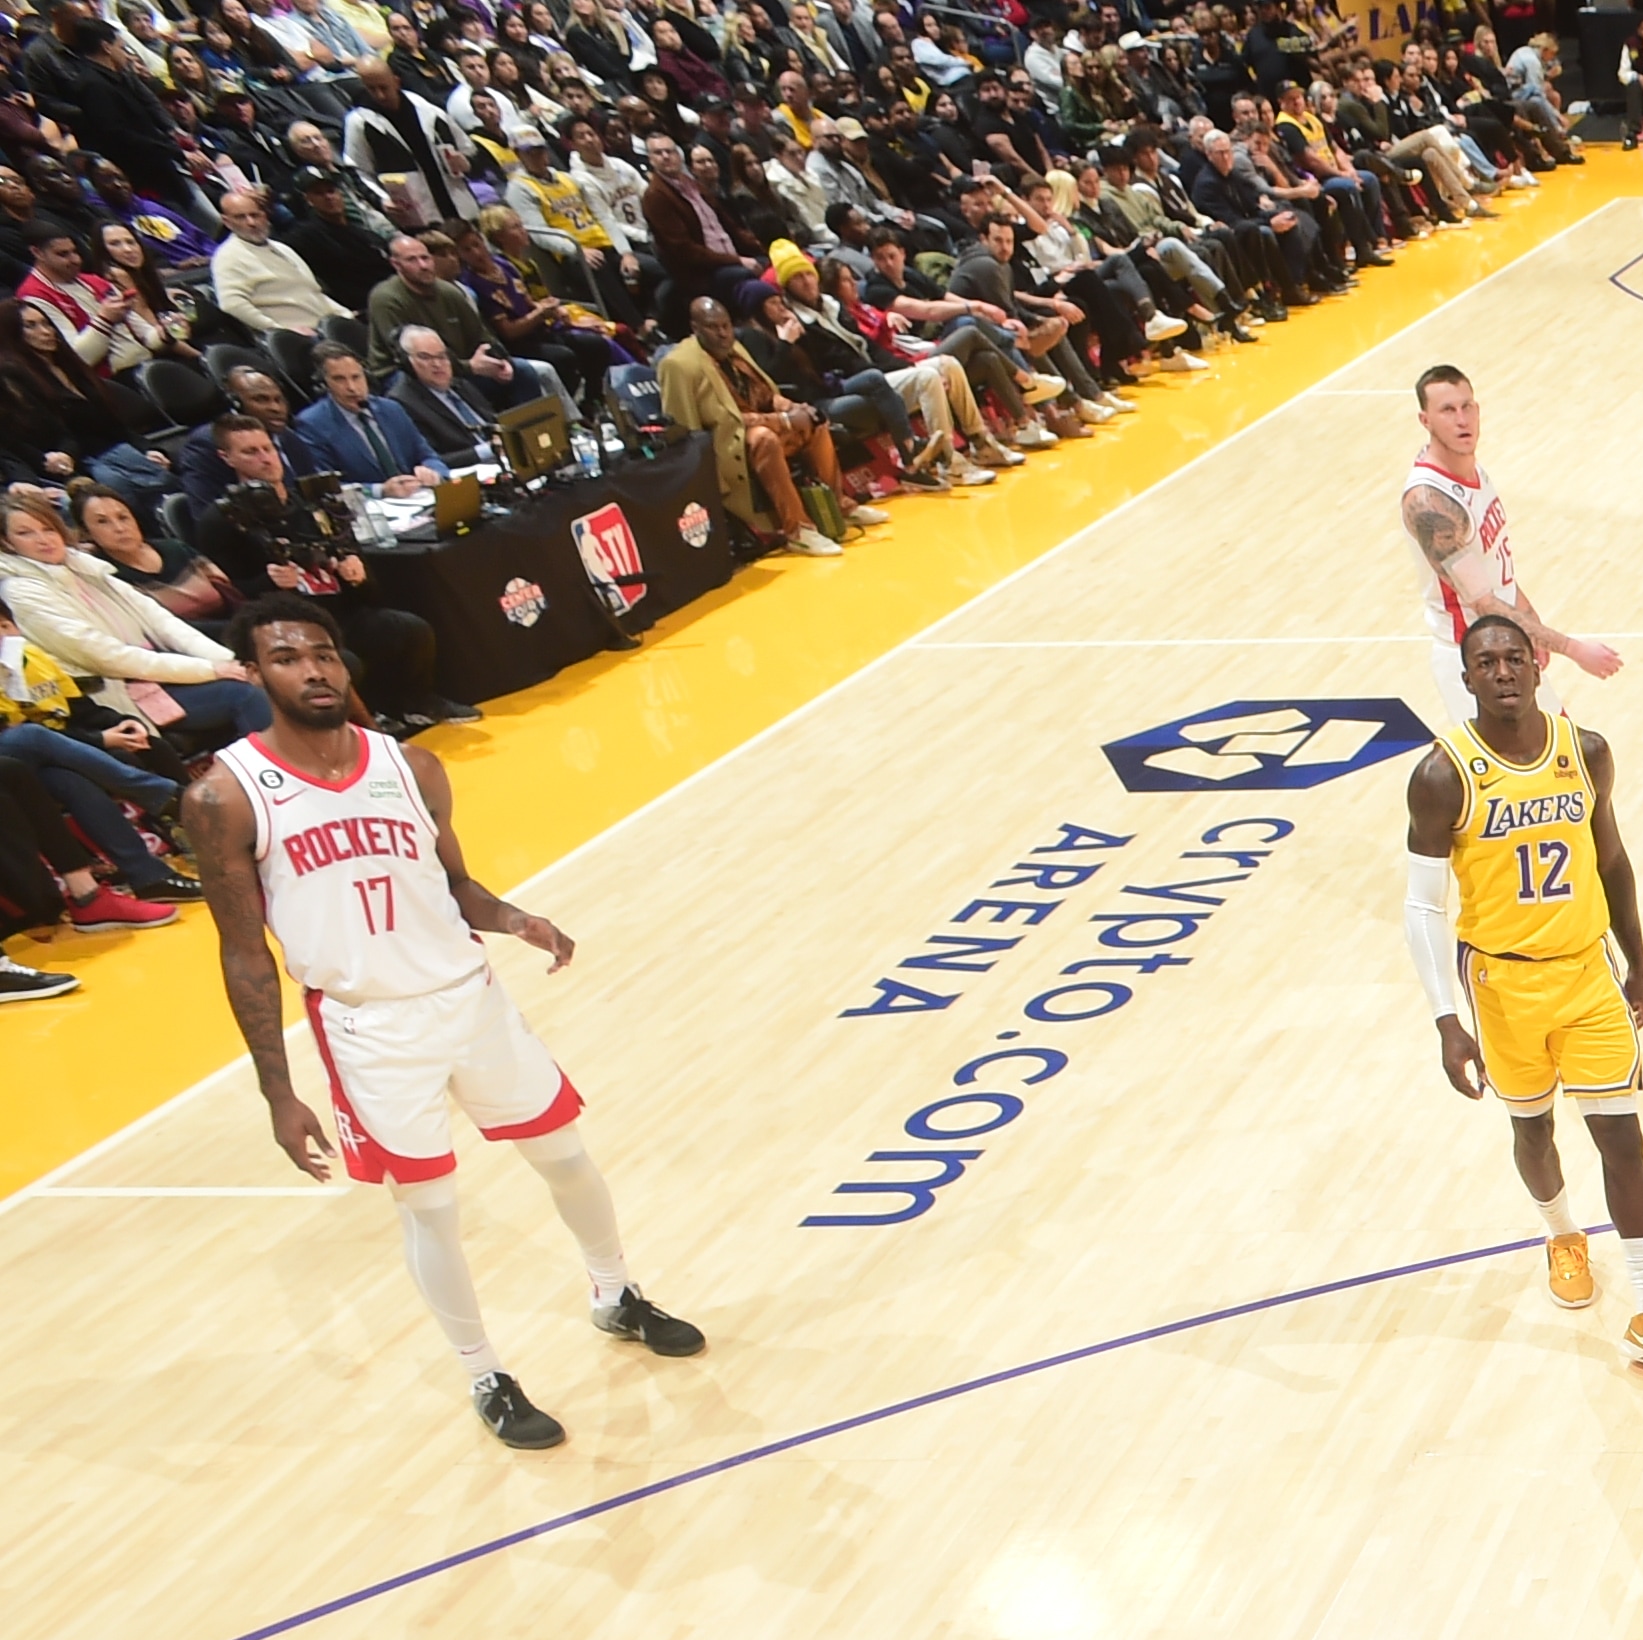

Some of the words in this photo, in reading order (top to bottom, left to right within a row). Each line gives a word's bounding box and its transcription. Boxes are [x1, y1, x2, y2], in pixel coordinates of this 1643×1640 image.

[601, 523, 634, 577] TV
[264, 773, 280, 786] 6
[1470, 758, 1488, 774] 6
[1477, 790, 1586, 840] LAKERS
[282, 816, 420, 877] ROCKETS
[1514, 840, 1573, 902] 12
[352, 875, 395, 936] 17
[836, 821, 1138, 1019] ARENA
[797, 816, 1296, 1228] crypto.com
